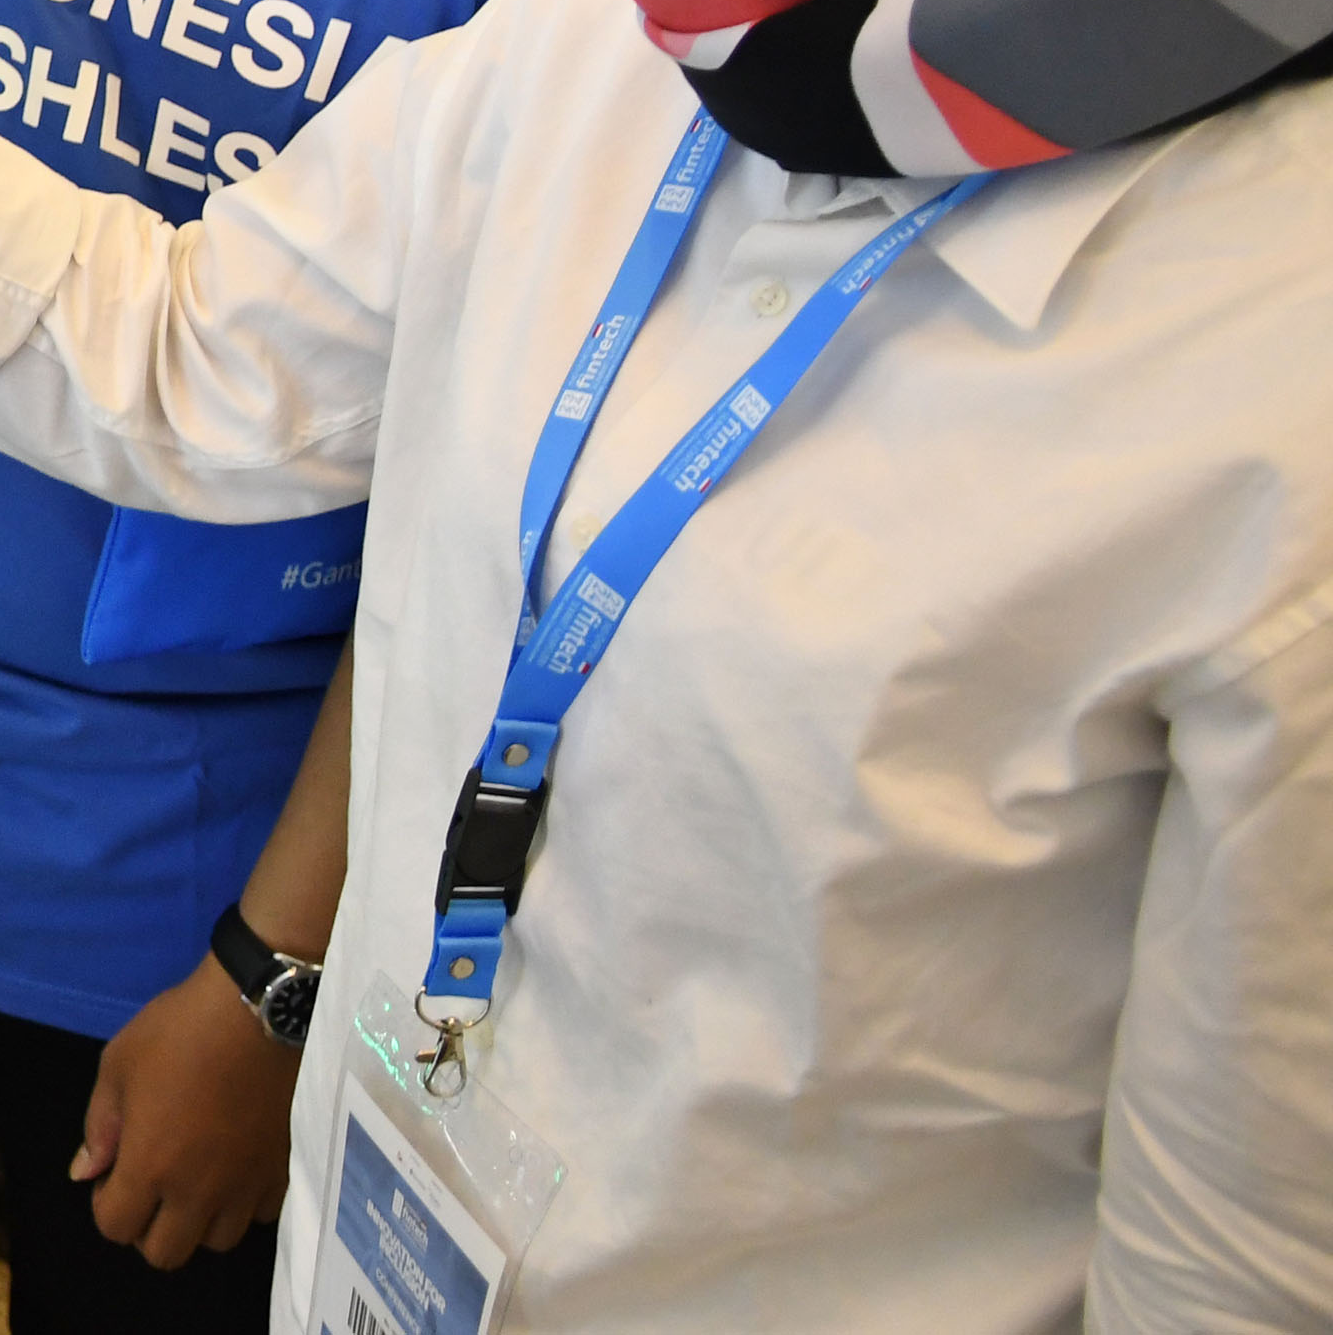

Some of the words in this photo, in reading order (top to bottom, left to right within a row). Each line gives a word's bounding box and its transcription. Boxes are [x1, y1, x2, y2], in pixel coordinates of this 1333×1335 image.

[576, 314, 625, 389] fintech
[675, 417, 742, 493] fintech
[548, 605, 603, 675] fintech
